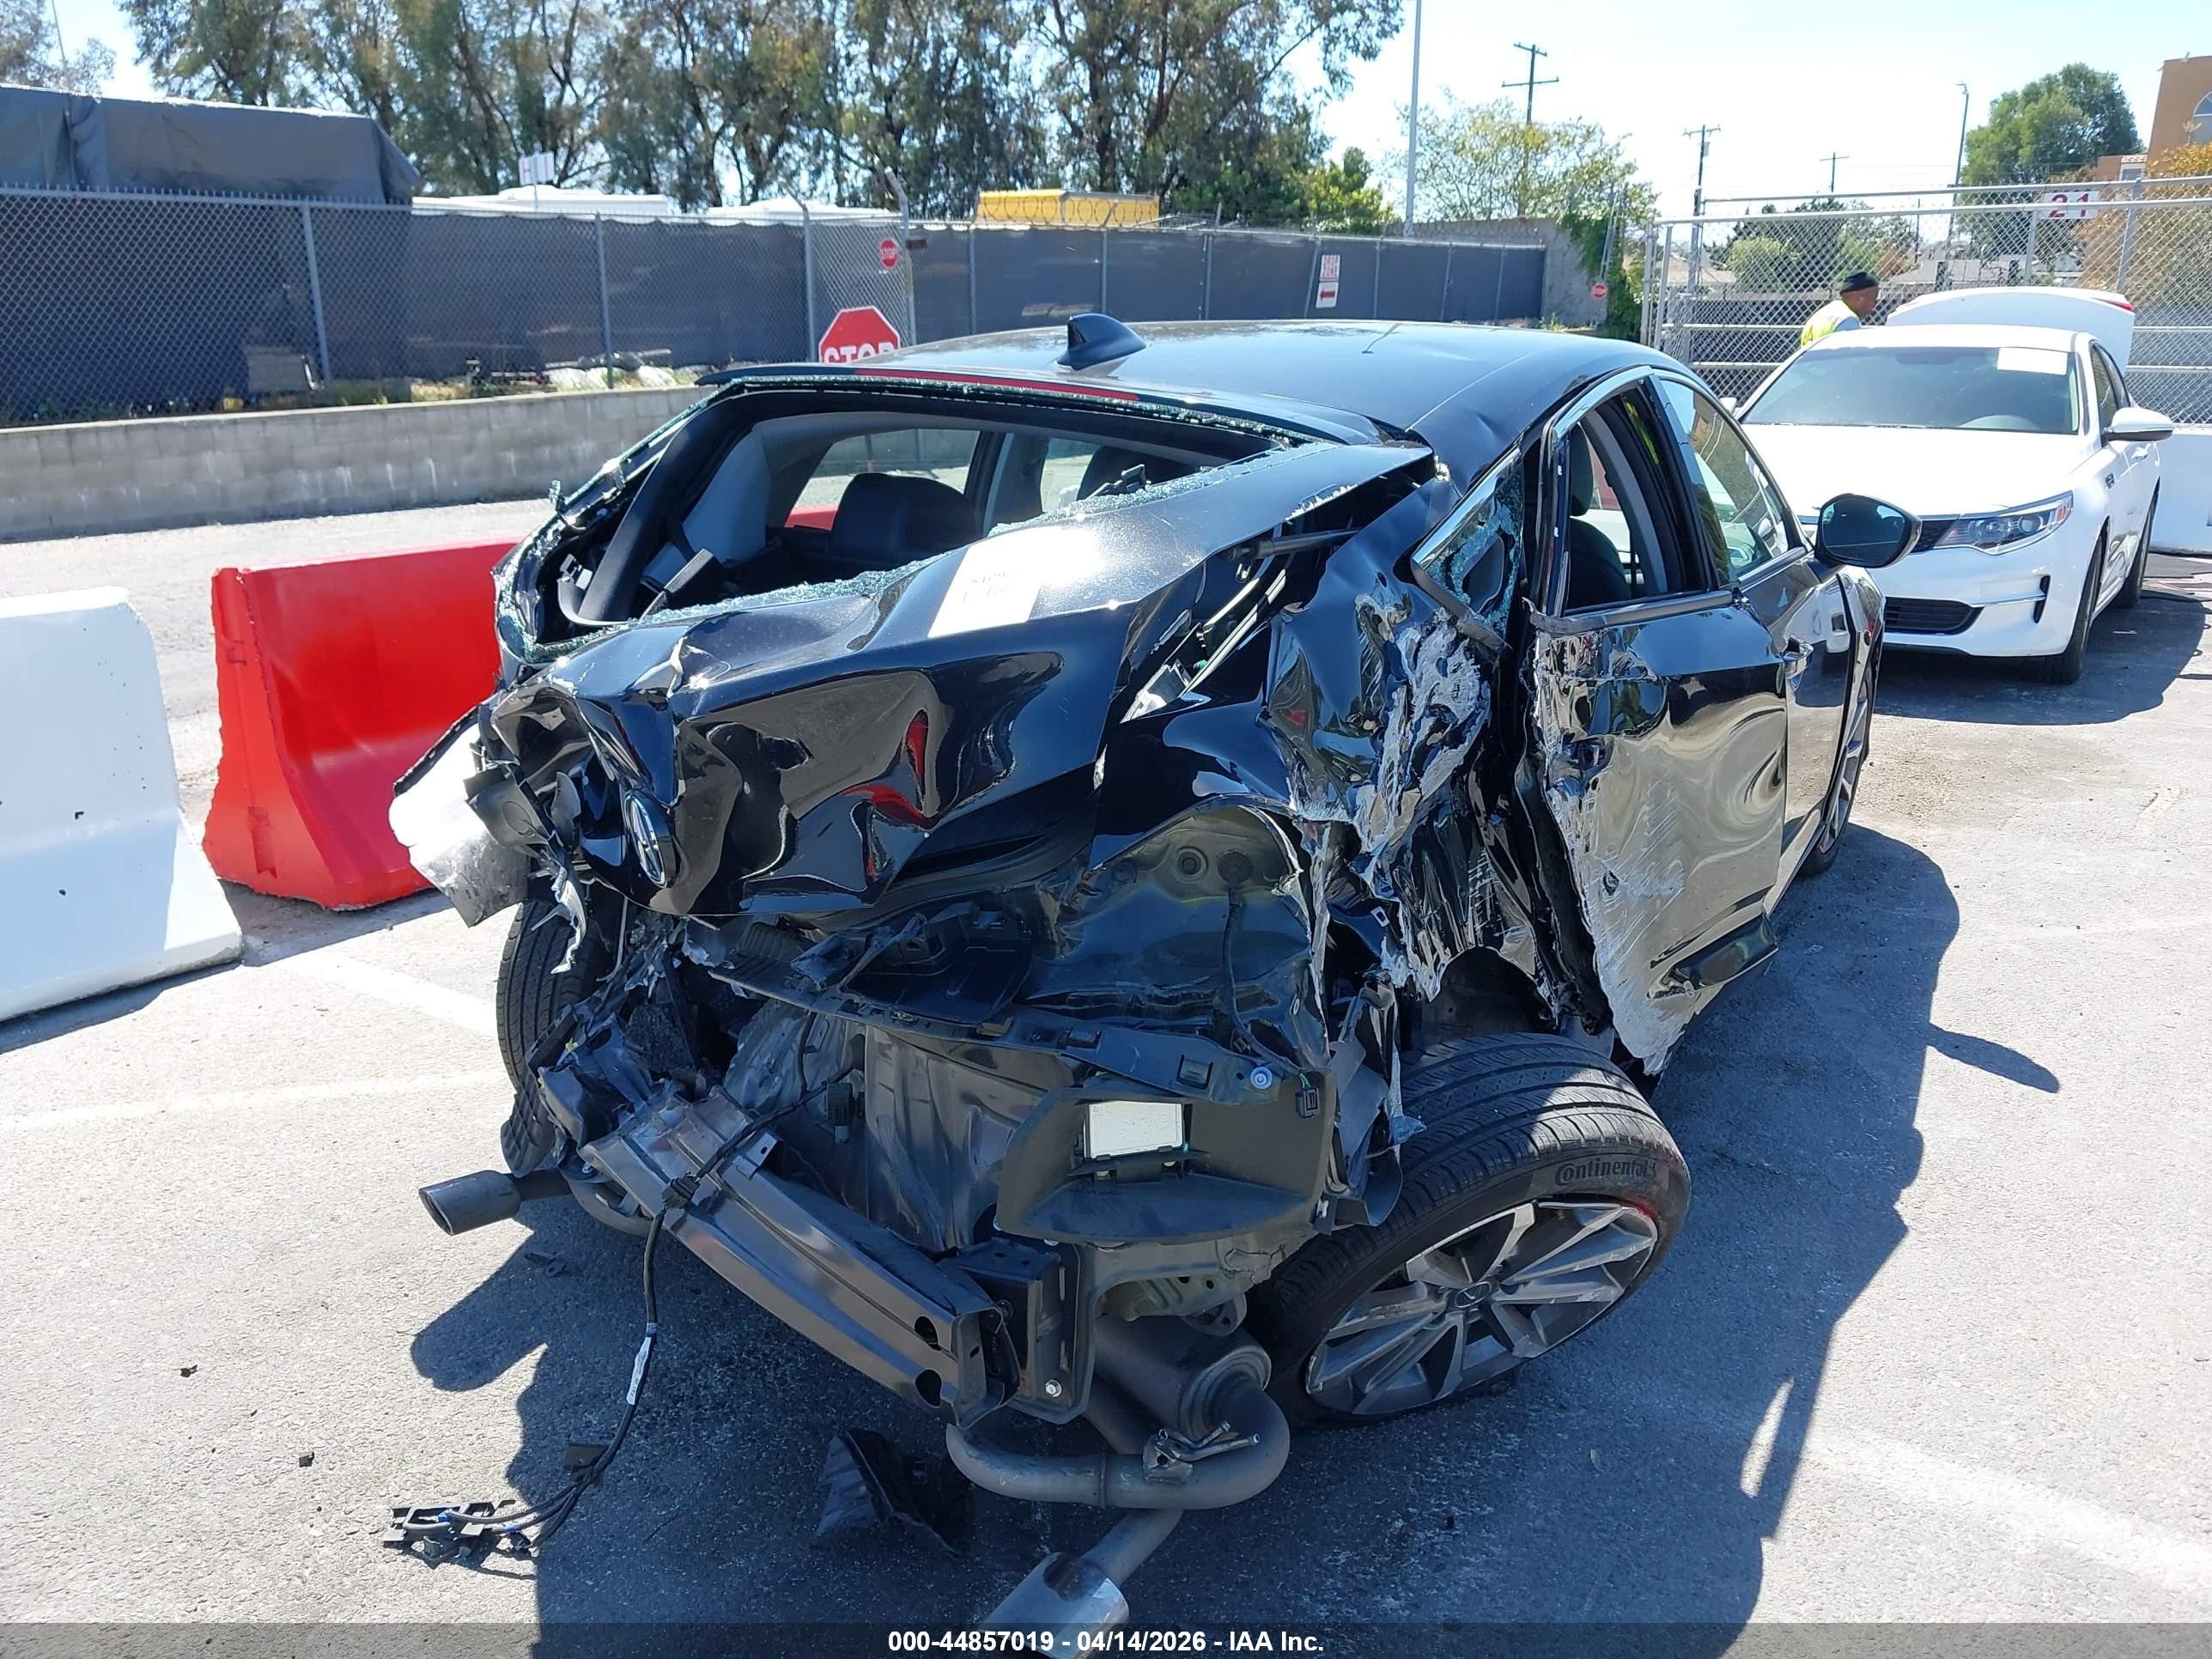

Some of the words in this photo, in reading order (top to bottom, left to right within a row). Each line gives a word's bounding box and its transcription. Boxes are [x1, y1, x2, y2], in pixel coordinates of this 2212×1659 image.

[2049, 193, 2089, 218] 21
[880, 247, 899, 260] STOP
[1555, 1158, 1650, 1187] Continental
